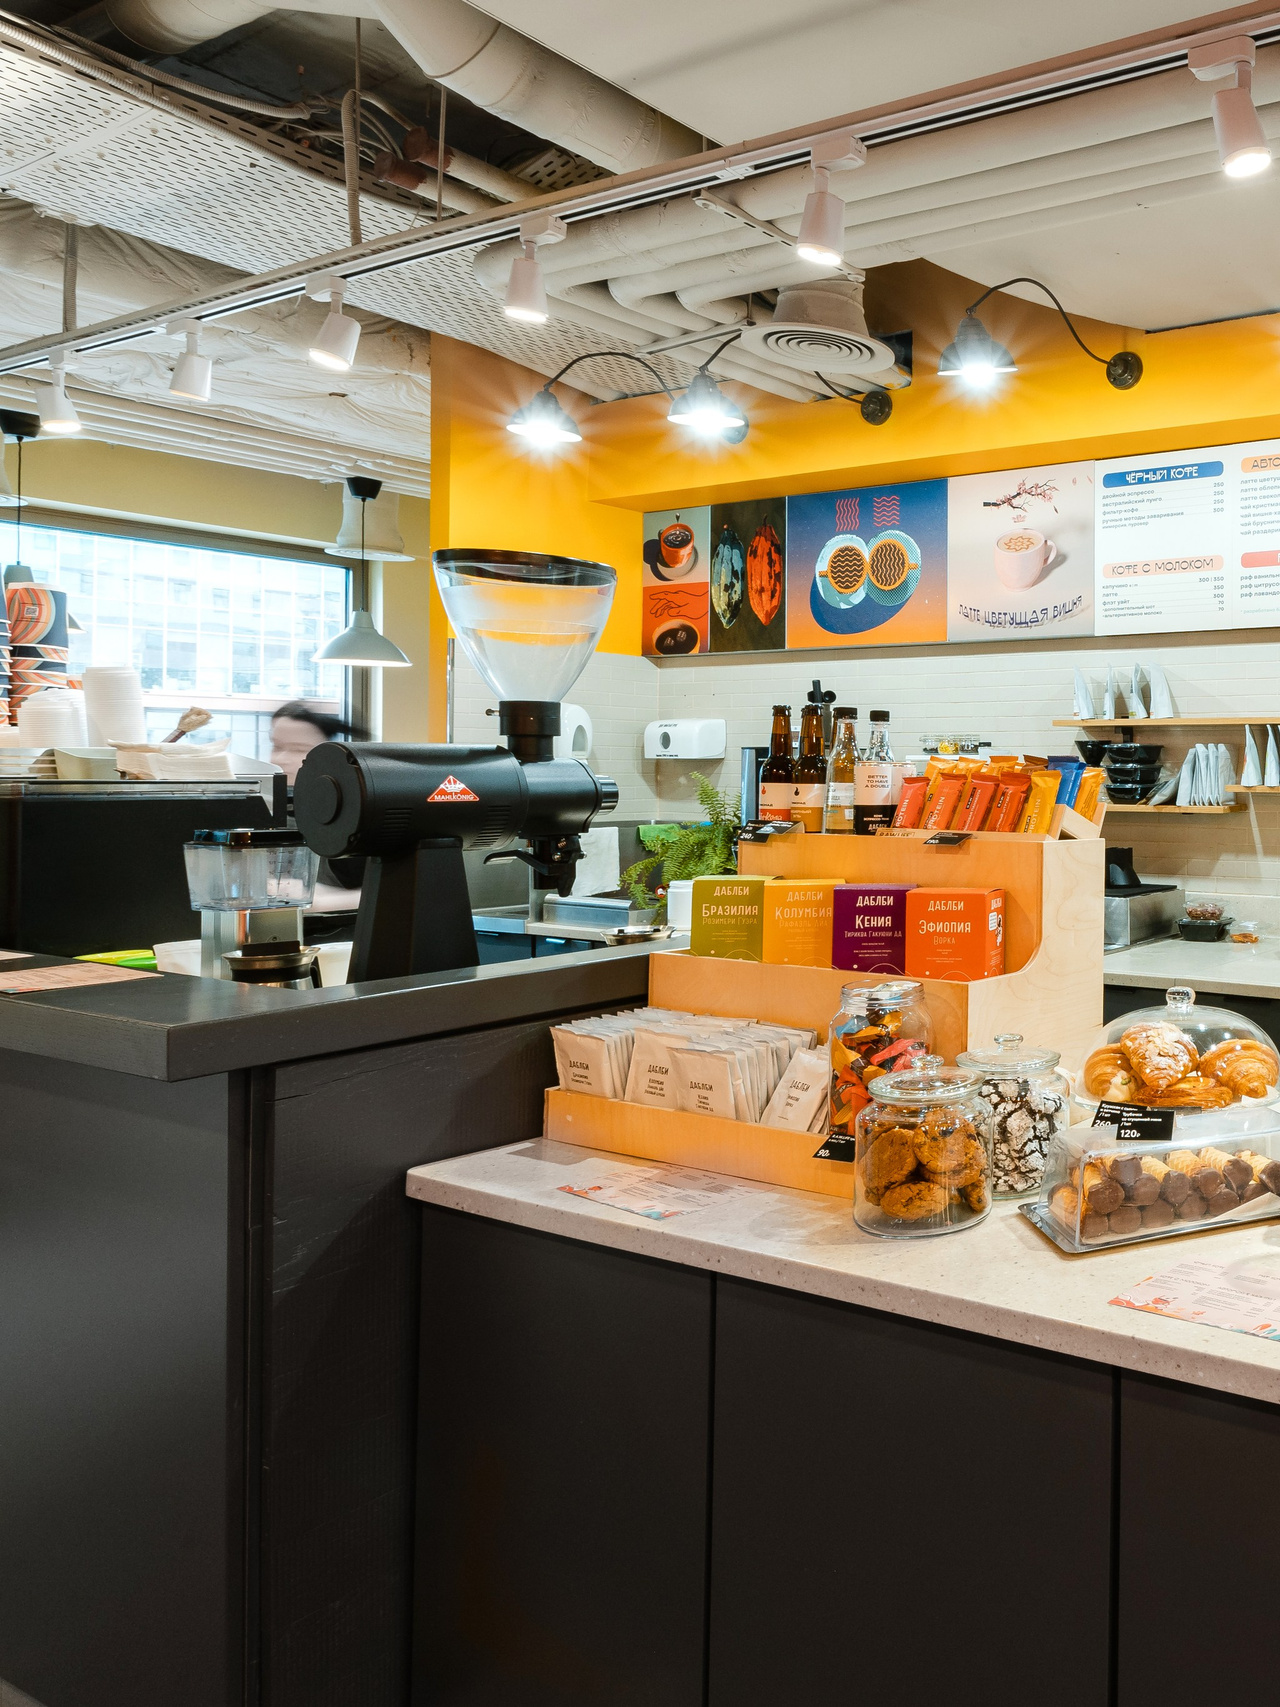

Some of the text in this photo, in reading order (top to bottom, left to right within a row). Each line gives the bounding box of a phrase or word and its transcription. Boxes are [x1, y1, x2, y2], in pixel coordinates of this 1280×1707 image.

[1126, 466, 1198, 483] ЧЁРНЫЙ КОФЕ
[1112, 559, 1213, 575] КОФЕ С МОЛОКОМ
[959, 604, 980, 621] ЛАТТЕ
[985, 608, 1048, 625] ЦВЕТУЩАЯ
[1053, 595, 1082, 618] ВИШНЯ
[714, 886, 749, 896] ДАБЛБИ
[787, 892, 822, 902] ДАБЛБИ
[856, 896, 893, 907] ДАБЛБИ
[928, 901, 964, 911] ДАБЛБИ
[569, 1060, 589, 1071] ДАБЛБИ
[648, 1064, 669, 1075] ДАБЛБИ
[690, 1081, 713, 1092] ДАБЛБИ
[790, 1080, 810, 1092] ДАБЛБИ
